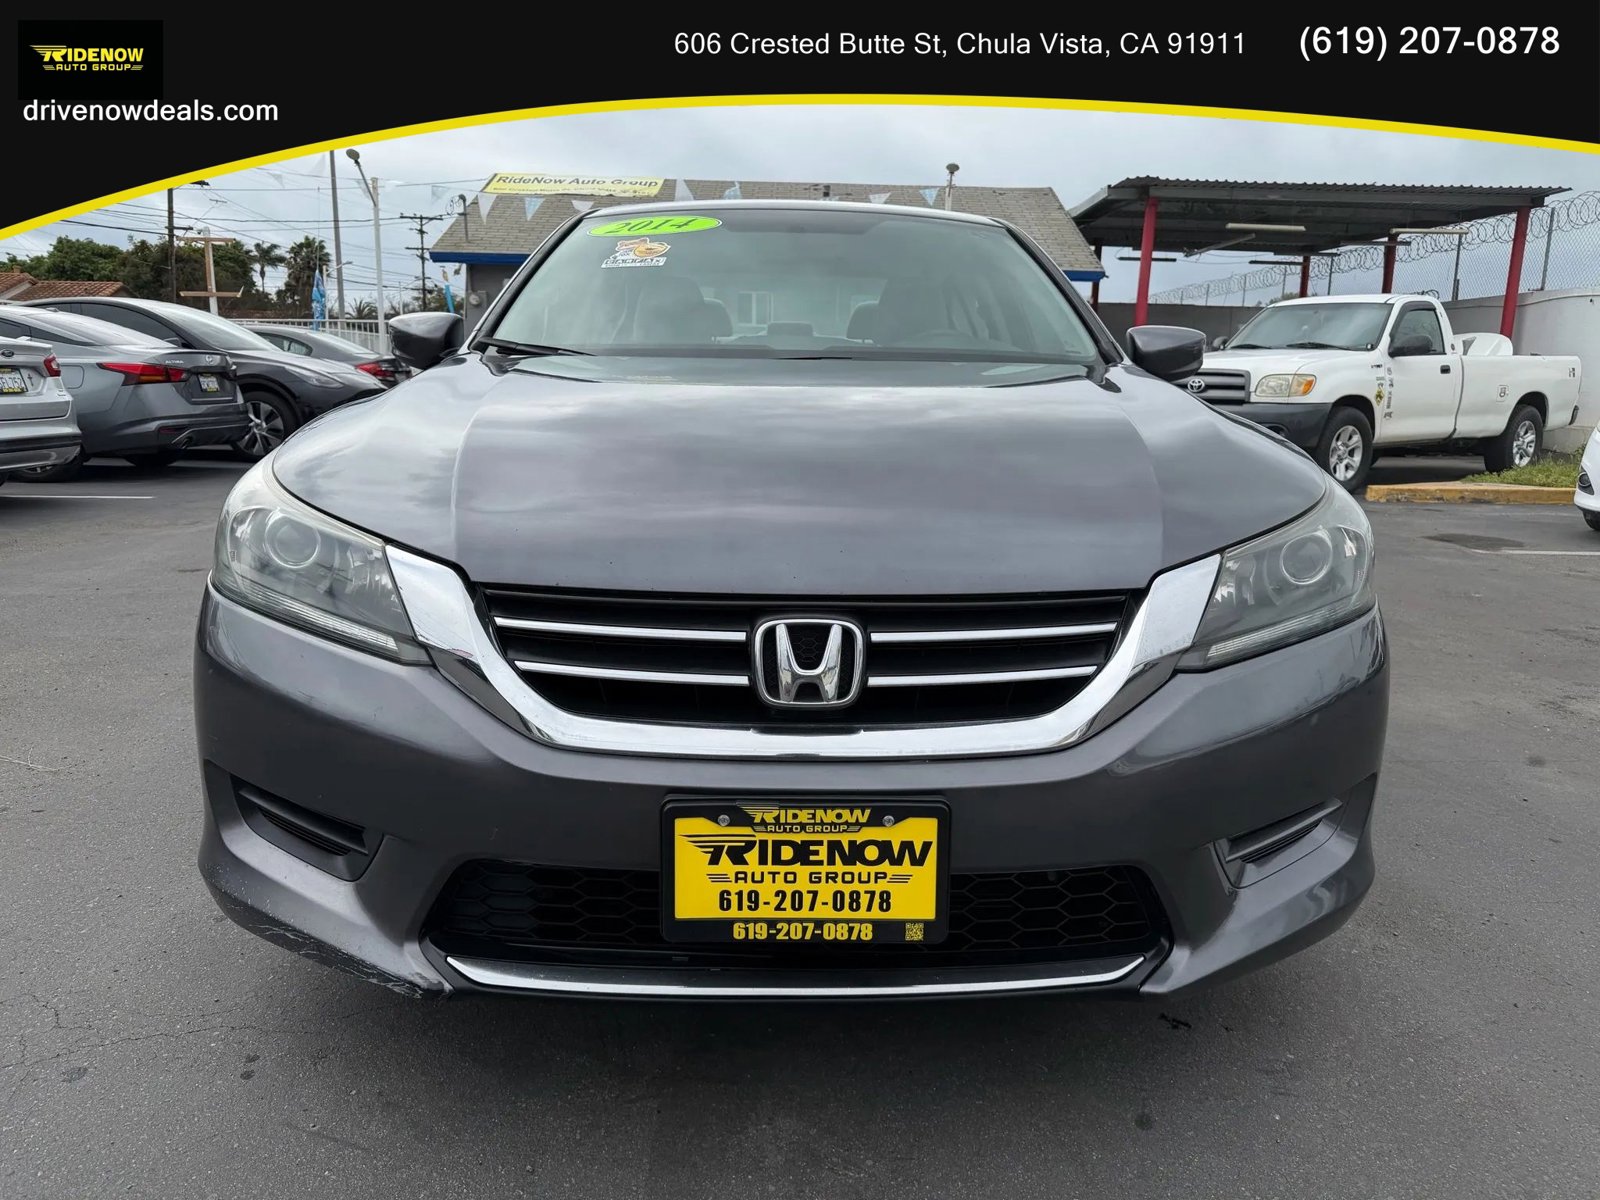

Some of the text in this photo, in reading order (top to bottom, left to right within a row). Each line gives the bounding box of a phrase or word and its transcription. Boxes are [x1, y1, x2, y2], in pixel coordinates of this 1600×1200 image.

[496, 176, 566, 184] RideNow
[611, 179, 658, 188] Group
[604, 218, 699, 234] 2014
[743, 805, 872, 823] RIDENOW
[690, 836, 934, 867] RIDENOW
[734, 871, 888, 885] AUTO GROUP
[718, 889, 892, 913] 619-207-0878
[732, 922, 874, 941] 619-207-0878
